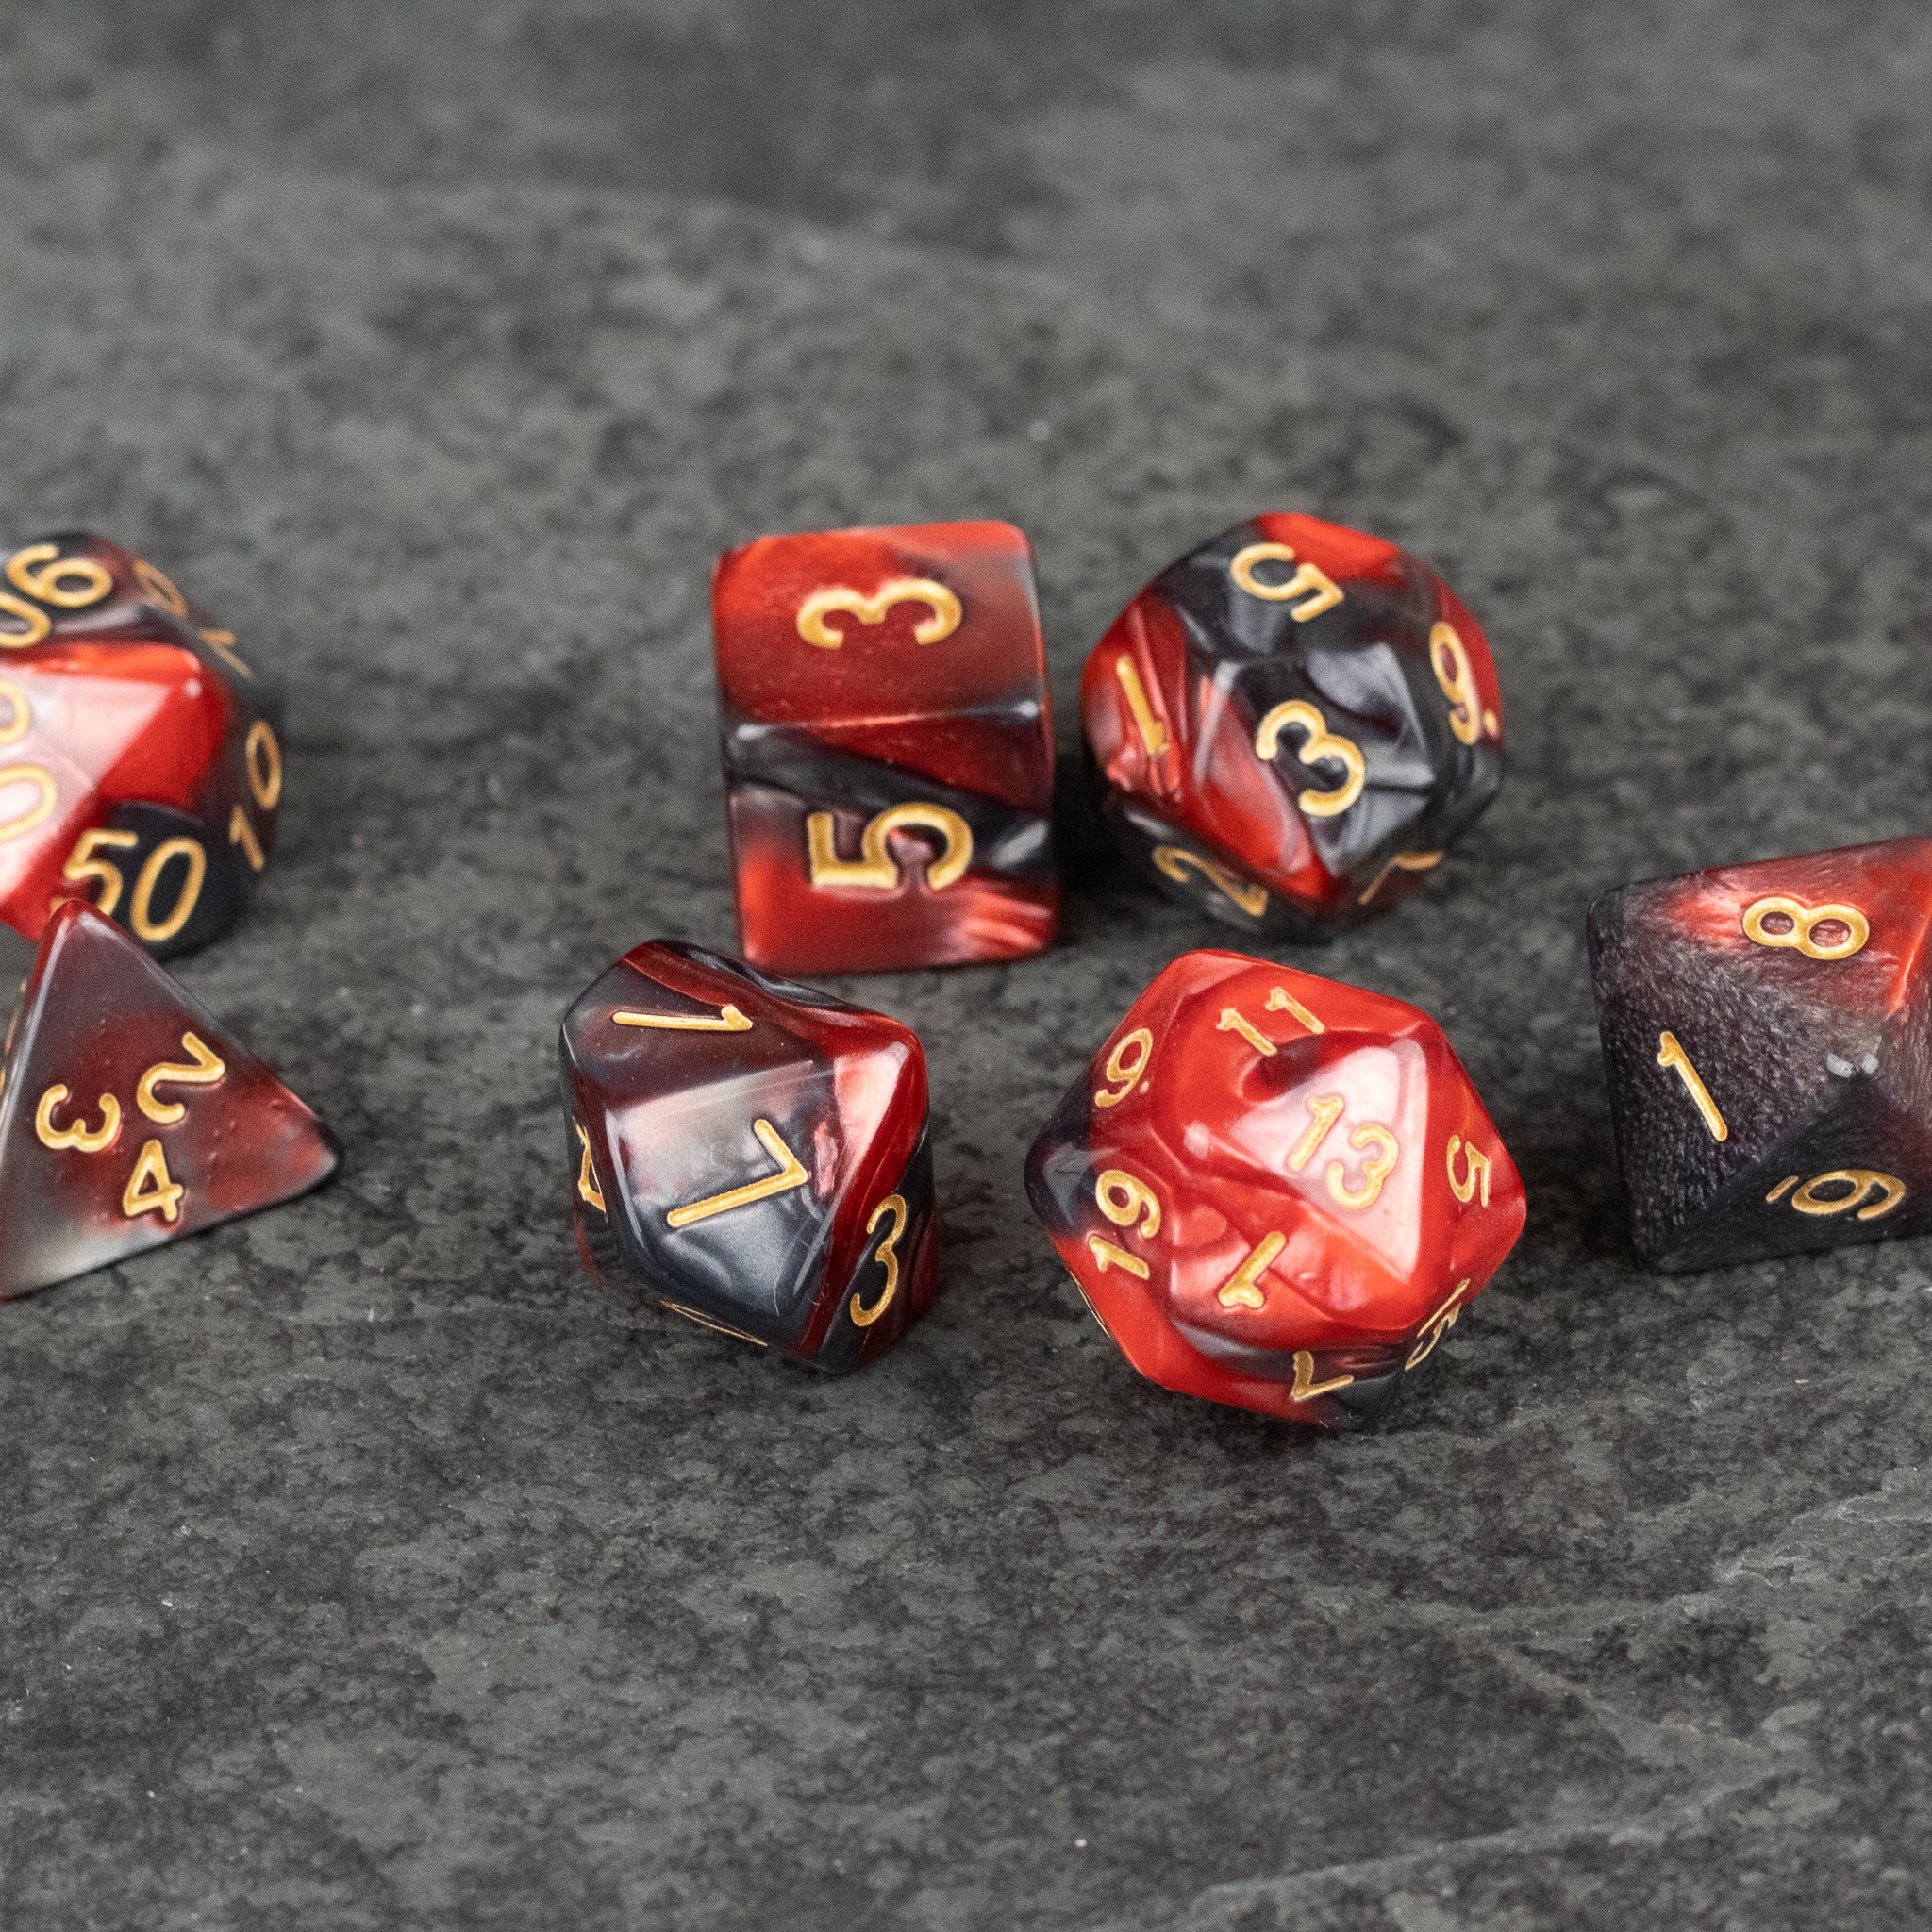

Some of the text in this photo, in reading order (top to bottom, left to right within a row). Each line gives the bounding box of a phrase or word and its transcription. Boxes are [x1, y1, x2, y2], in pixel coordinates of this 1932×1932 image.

[797, 578, 961, 649] 3
[1231, 543, 1344, 622] 5
[1117, 656, 1170, 755] 1
[1256, 700, 1365, 816] 3
[52, 828, 207, 941] 50
[807, 802, 973, 891] 5
[1151, 847, 1268, 917] 2
[1742, 897, 1870, 960] 8
[1217, 988, 1324, 1057] 11
[36, 1084, 121, 1153] 3
[137, 1032, 225, 1124] 2
[1657, 1031, 1728, 1141] 1
[123, 1140, 184, 1222] 4
[667, 1120, 807, 1227] 7
[1290, 1092, 1399, 1208] 13
[1446, 1135, 1491, 1208] 5
[850, 1194, 907, 1326] 3
[1089, 1170, 1161, 1280] 19
[1218, 1230, 1287, 1309] 1
[1291, 1351, 1354, 1402] 7
